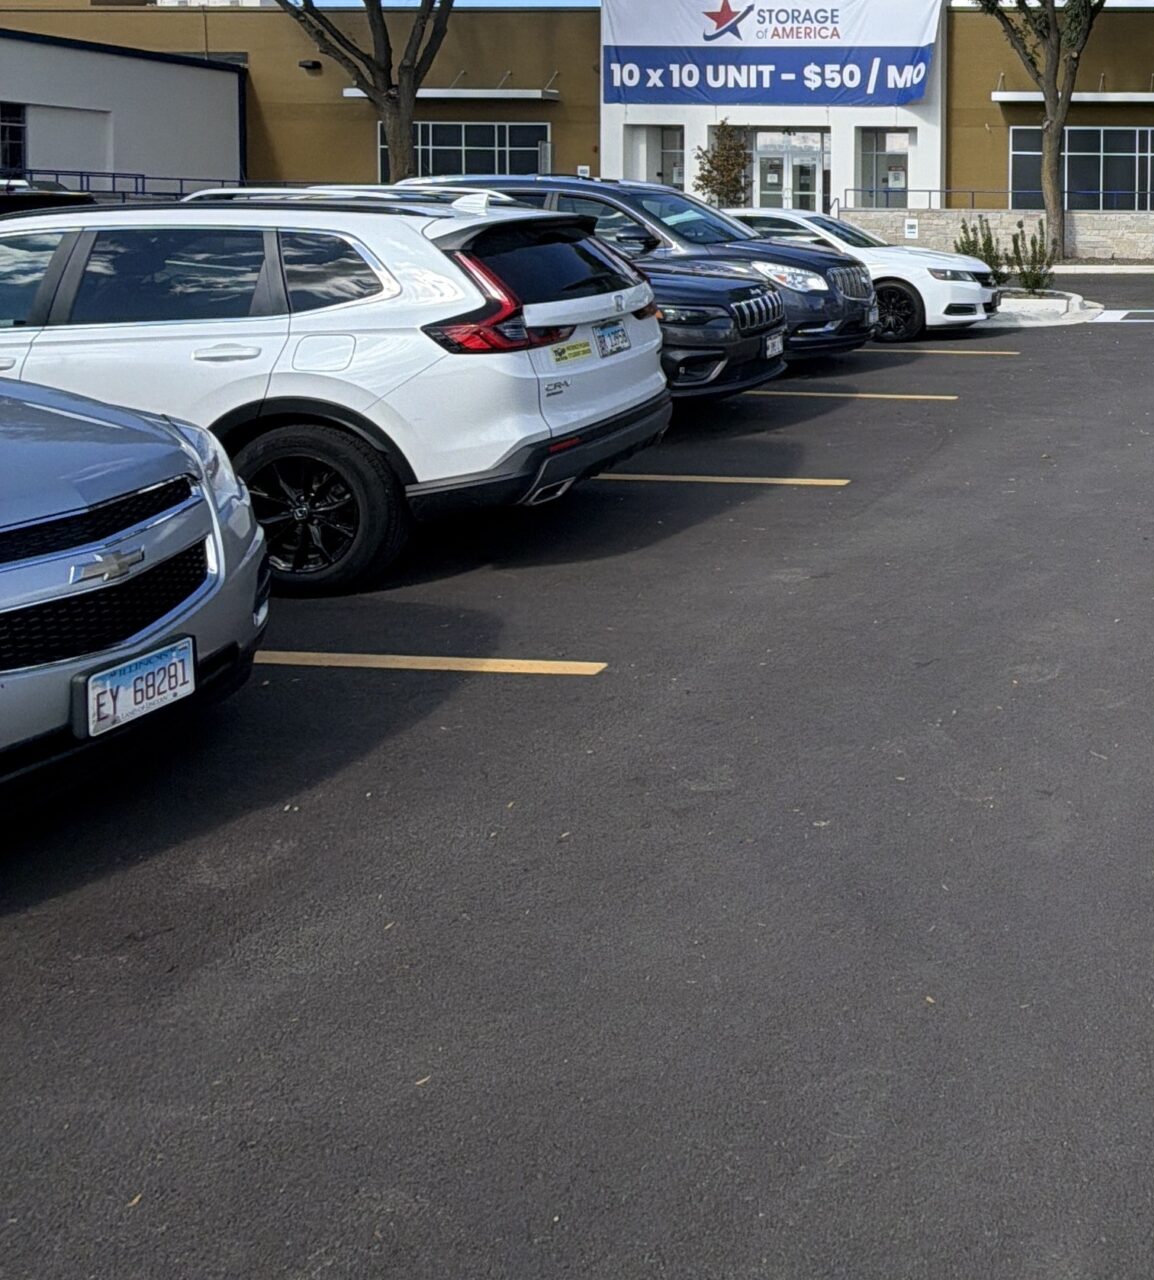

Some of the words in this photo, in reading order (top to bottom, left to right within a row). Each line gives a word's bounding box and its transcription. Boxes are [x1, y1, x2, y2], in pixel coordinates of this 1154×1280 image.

[757, 8, 839, 24] STORAGE
[756, 28, 768, 39] of
[770, 26, 841, 39] AMERICA
[610, 63, 640, 87] 10
[645, 69, 665, 87] x
[669, 63, 700, 88] 10
[706, 64, 776, 89] UNIT
[803, 62, 861, 91] $50
[866, 57, 881, 94] /
[887, 62, 926, 88] MO
[96, 685, 120, 722] EY
[133, 658, 190, 706] 68281
